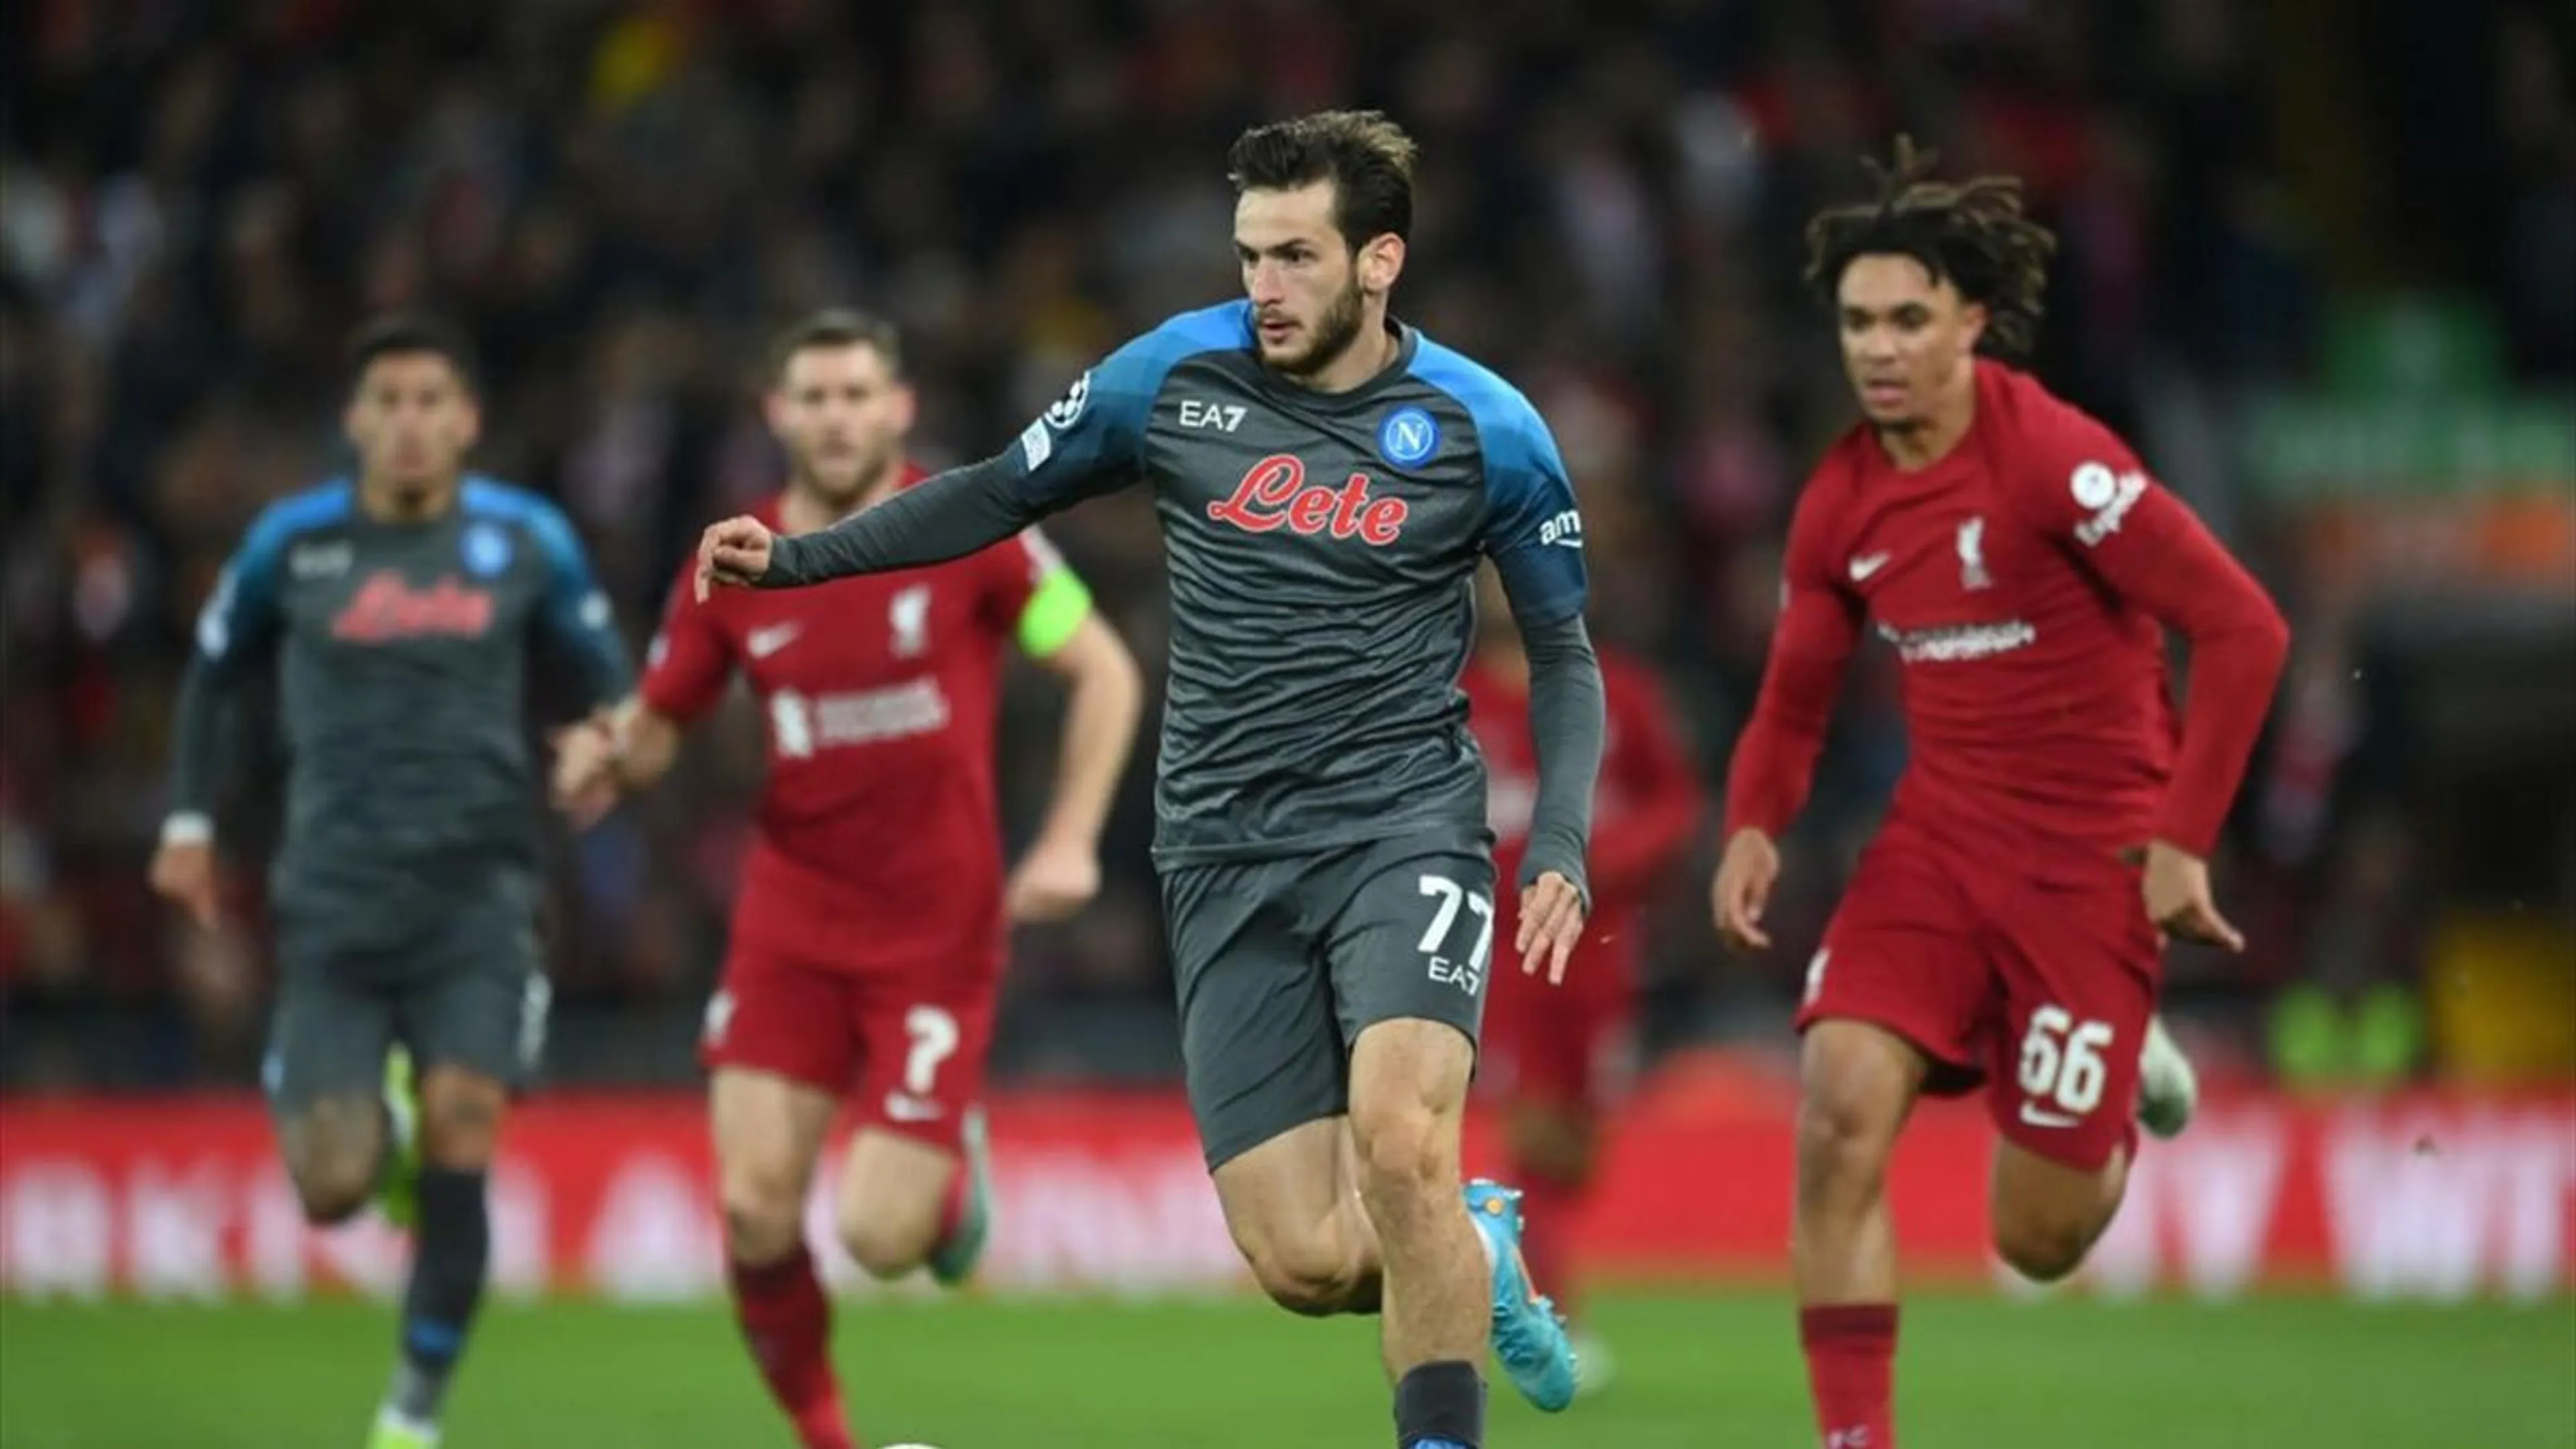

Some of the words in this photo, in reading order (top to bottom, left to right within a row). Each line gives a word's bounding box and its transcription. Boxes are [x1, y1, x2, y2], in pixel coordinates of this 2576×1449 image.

[1180, 400, 1247, 433] EA7
[1395, 421, 1424, 451] N
[1205, 453, 1408, 546] Lete
[1417, 874, 1495, 973] 77
[1428, 955, 1480, 996] EA7
[904, 1002, 959, 1095] 7
[2018, 1004, 2115, 1114] 66
